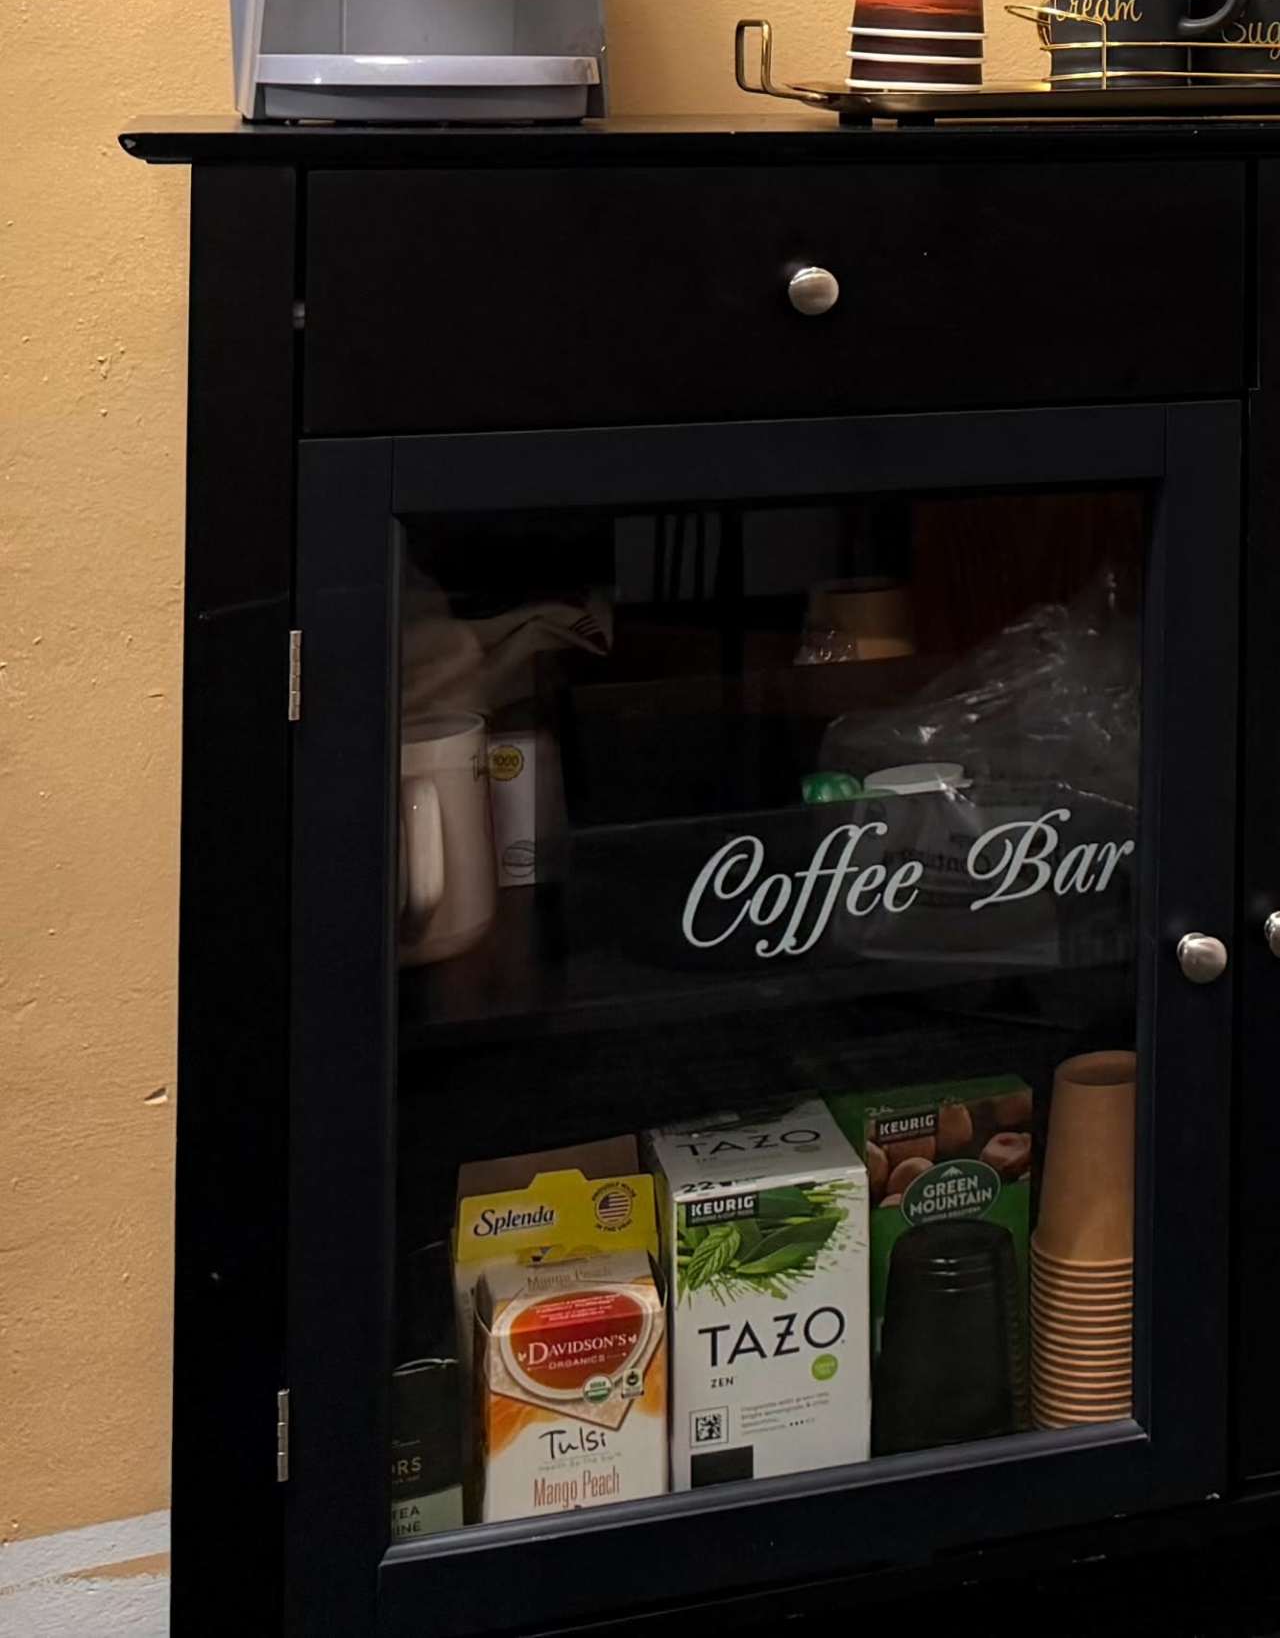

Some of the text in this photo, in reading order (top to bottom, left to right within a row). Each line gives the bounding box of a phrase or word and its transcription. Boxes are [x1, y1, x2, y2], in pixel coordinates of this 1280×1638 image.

[681, 807, 1136, 959] Coffee Bar
[879, 1113, 936, 1136] KEURIG
[675, 1128, 821, 1157] TAZO
[909, 1186, 993, 1217] MOUNTAIN
[922, 1174, 979, 1199] GREEN
[473, 1205, 555, 1237] Splenda
[690, 1195, 756, 1217] KEURIG
[528, 1333, 628, 1366] DAVIDSON'S
[697, 1306, 846, 1368] TAZO
[710, 1376, 735, 1389] ZEN
[538, 1426, 607, 1460] Tulsi
[533, 1465, 621, 1509] Mango Peach
[393, 1520, 422, 1536] INE
